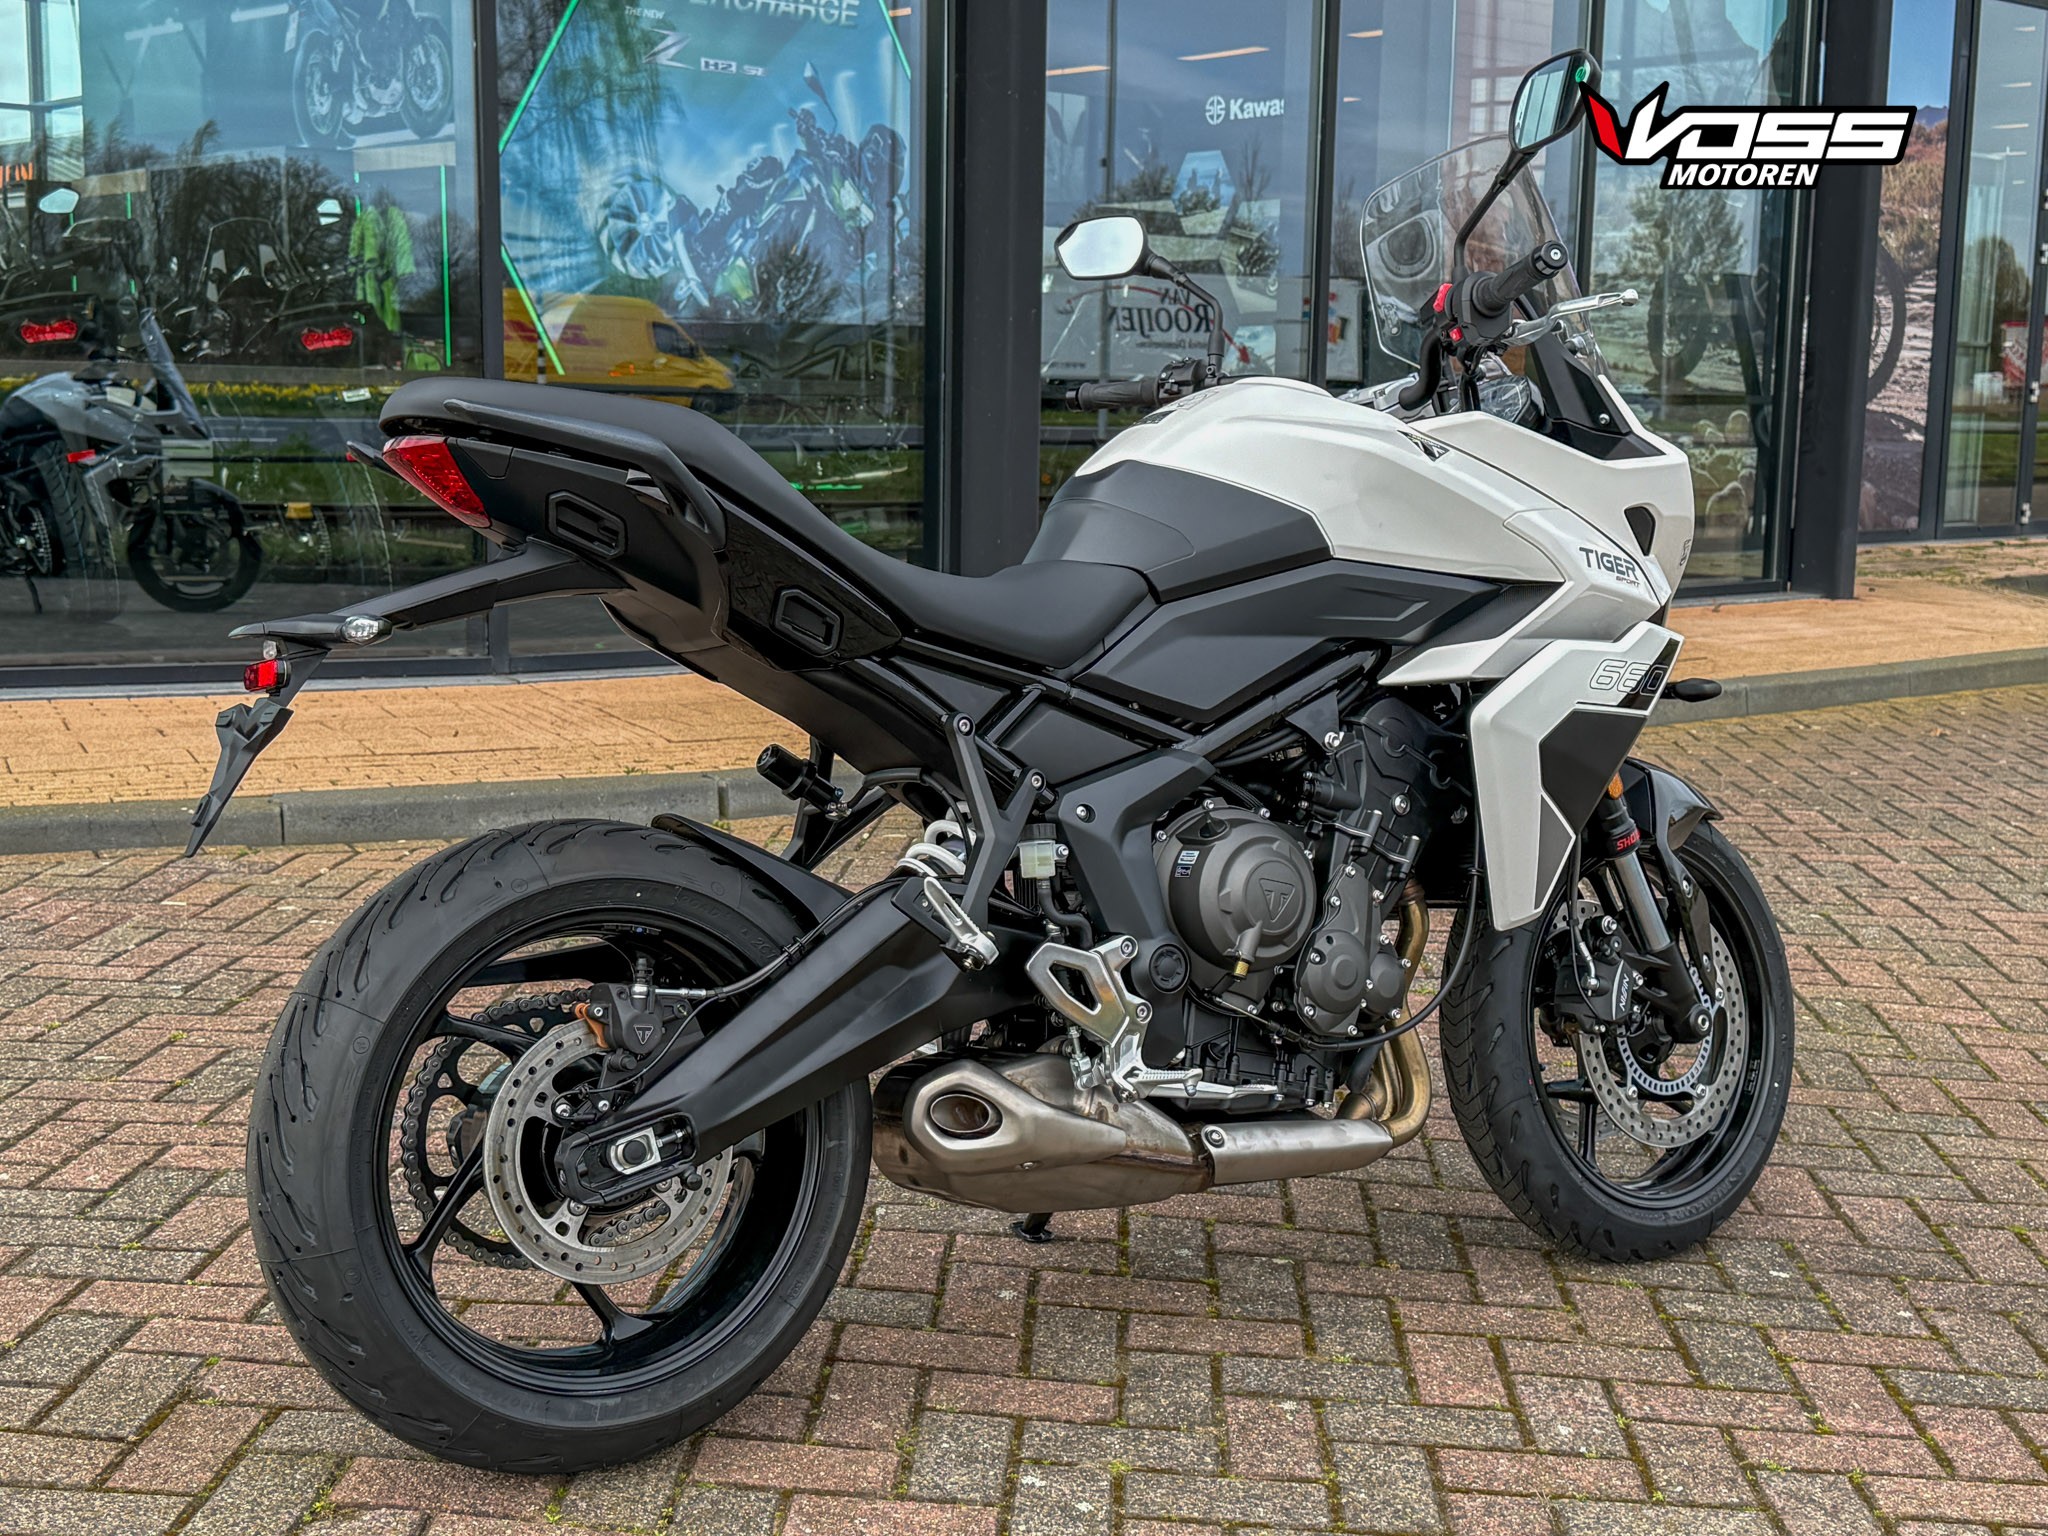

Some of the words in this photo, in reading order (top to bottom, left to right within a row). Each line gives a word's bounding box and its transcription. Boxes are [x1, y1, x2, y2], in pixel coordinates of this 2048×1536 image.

[624, 6, 641, 17] THE
[643, 9, 665, 19] NEW
[702, 58, 736, 73] H2
[1579, 546, 1639, 581] TIGER
[1589, 658, 1668, 697] 660
